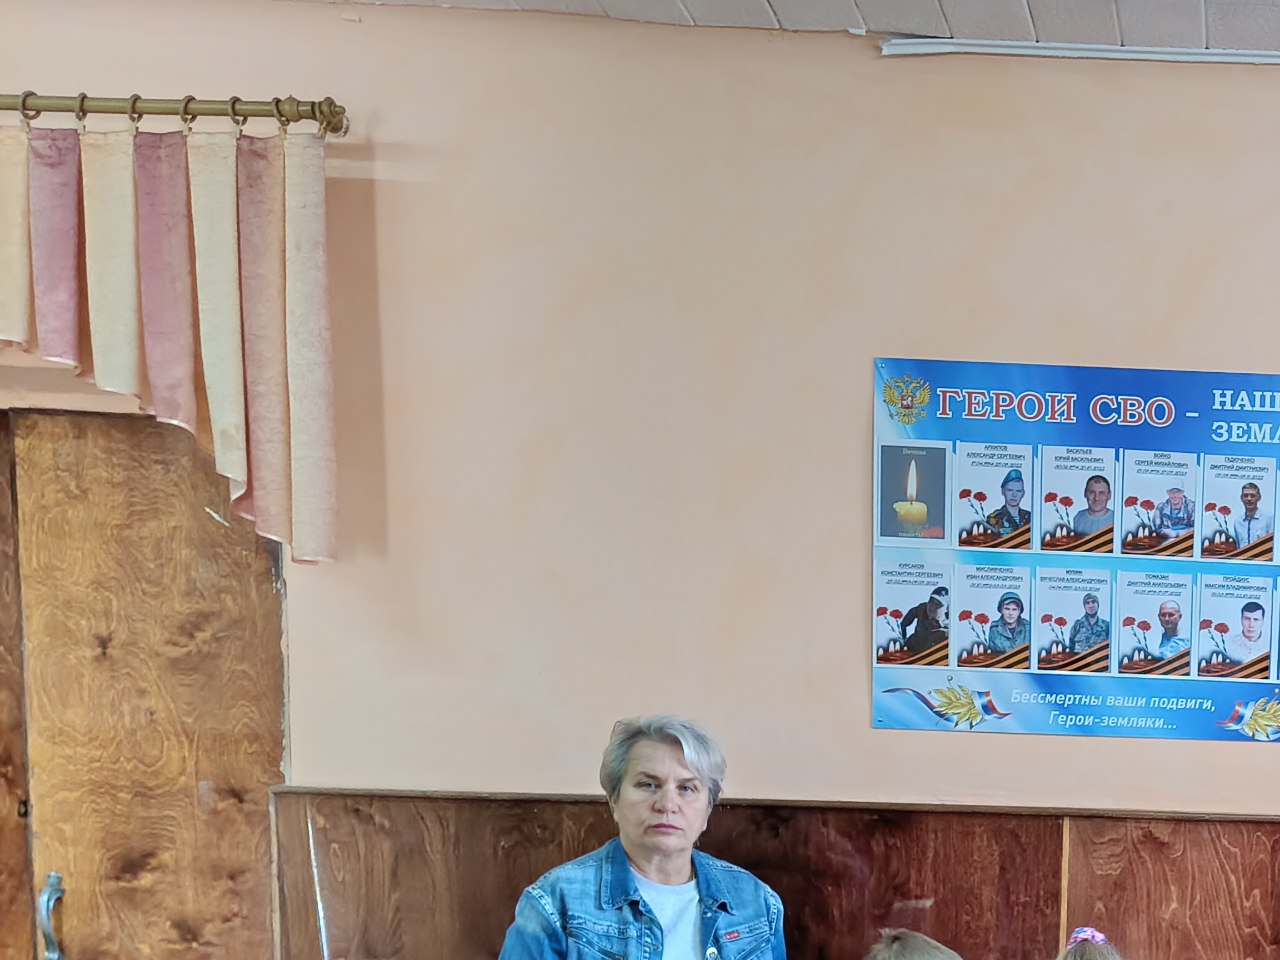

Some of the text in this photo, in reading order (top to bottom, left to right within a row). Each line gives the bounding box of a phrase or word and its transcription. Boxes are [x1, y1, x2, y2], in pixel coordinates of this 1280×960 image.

[937, 388, 1077, 424] ГЕРОИ
[1090, 396, 1175, 427] СВО
[1010, 689, 1216, 712] Бессмертны ваши подвиги,
[1048, 711, 1177, 730] Герои-земляки...
